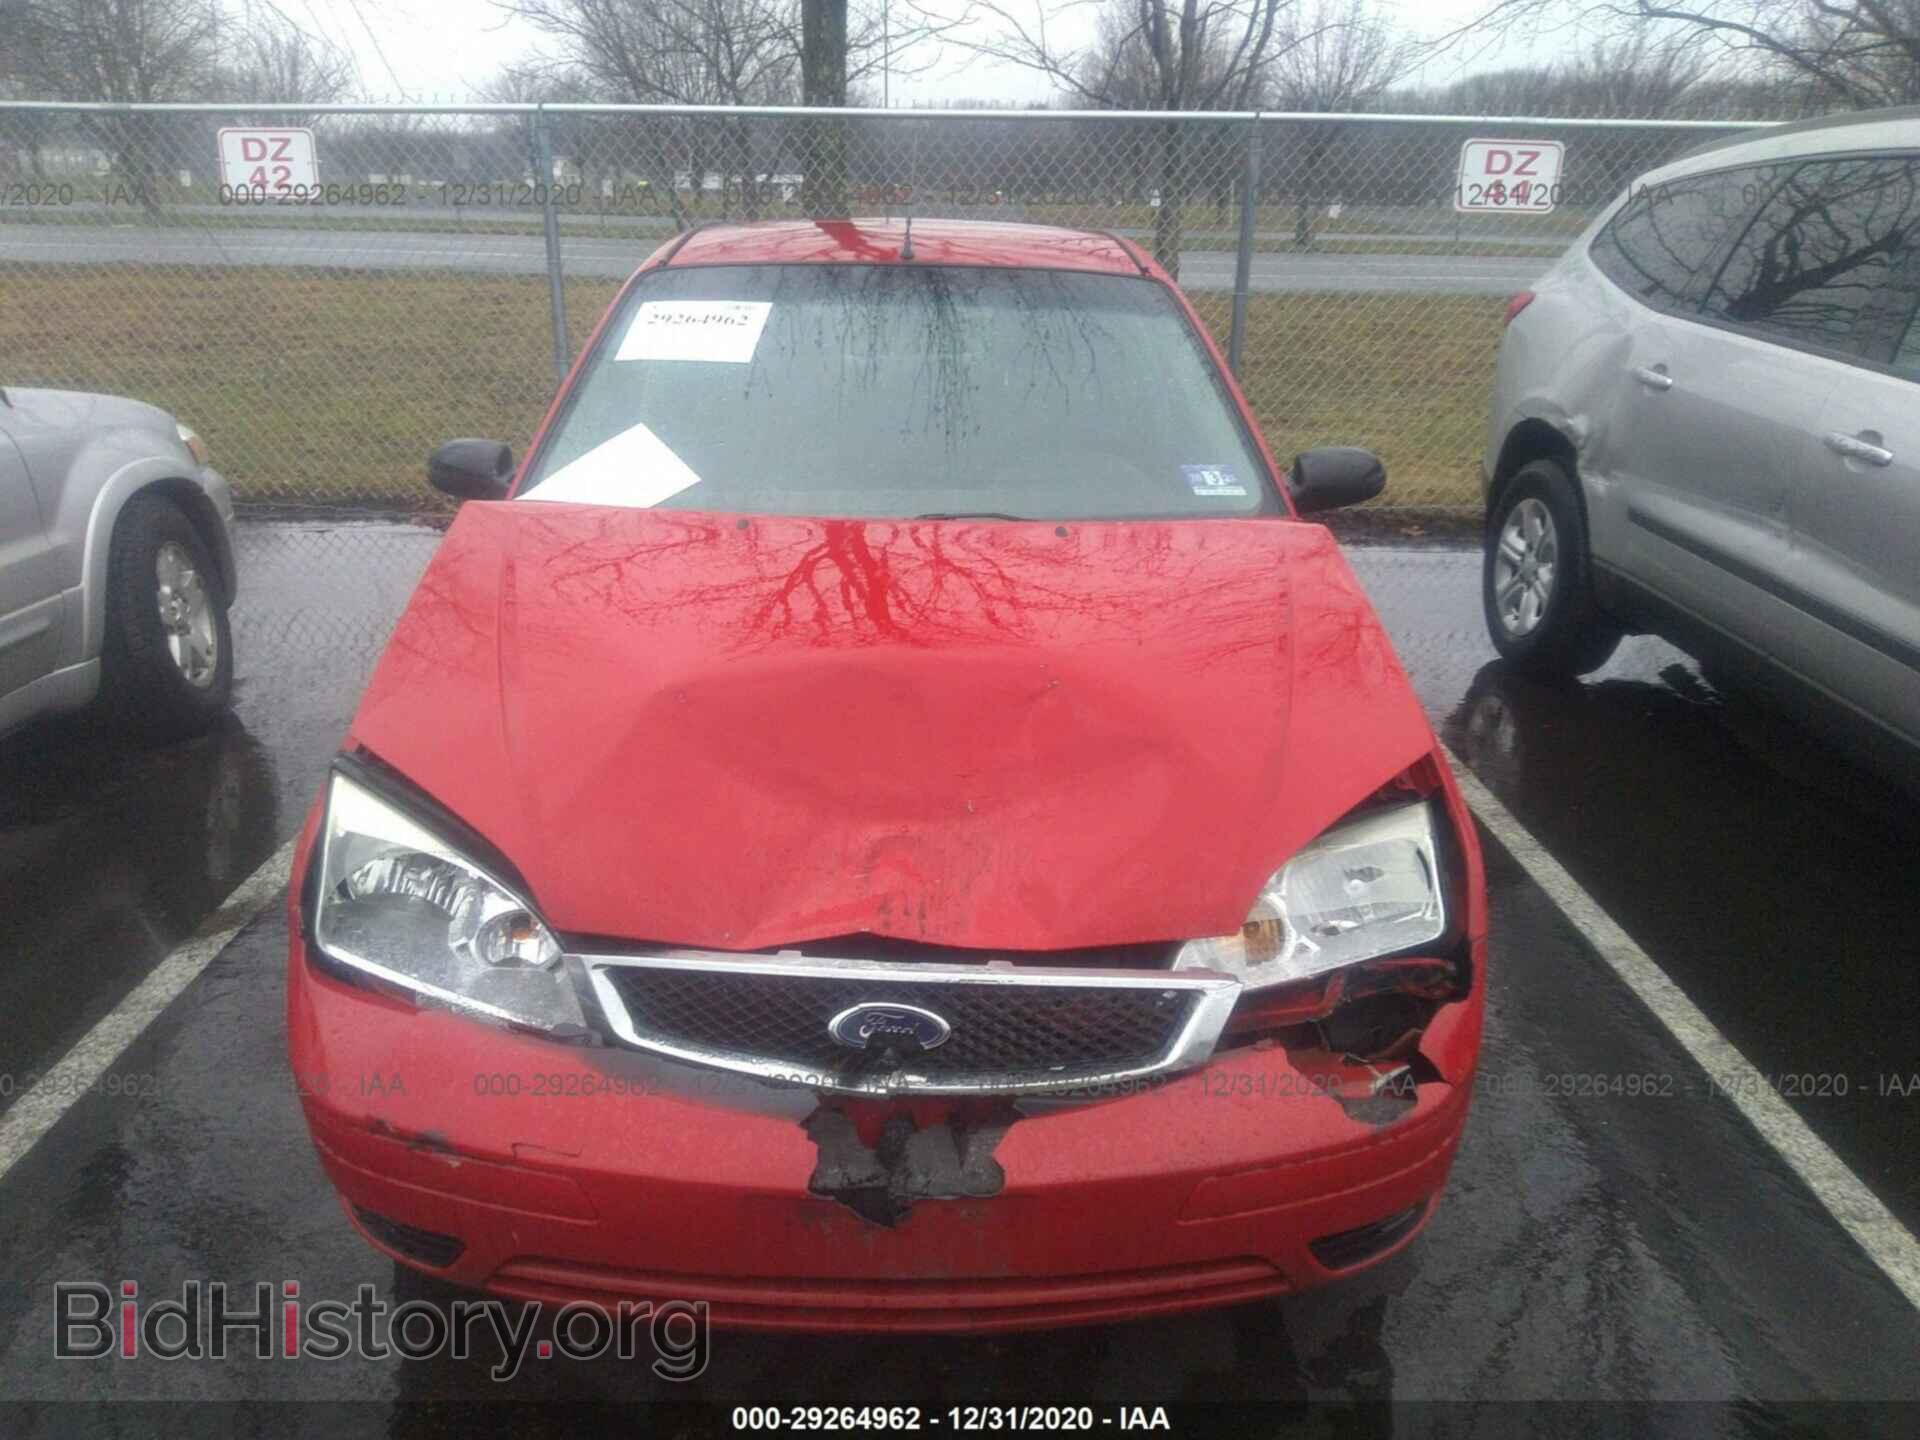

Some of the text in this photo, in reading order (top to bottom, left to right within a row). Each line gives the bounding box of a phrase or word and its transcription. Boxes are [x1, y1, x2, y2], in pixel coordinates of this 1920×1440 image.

[241, 137, 294, 162] DZ
[1483, 149, 1540, 176] DZ
[249, 165, 292, 191] 42
[859, 1011, 920, 1039] Ford
